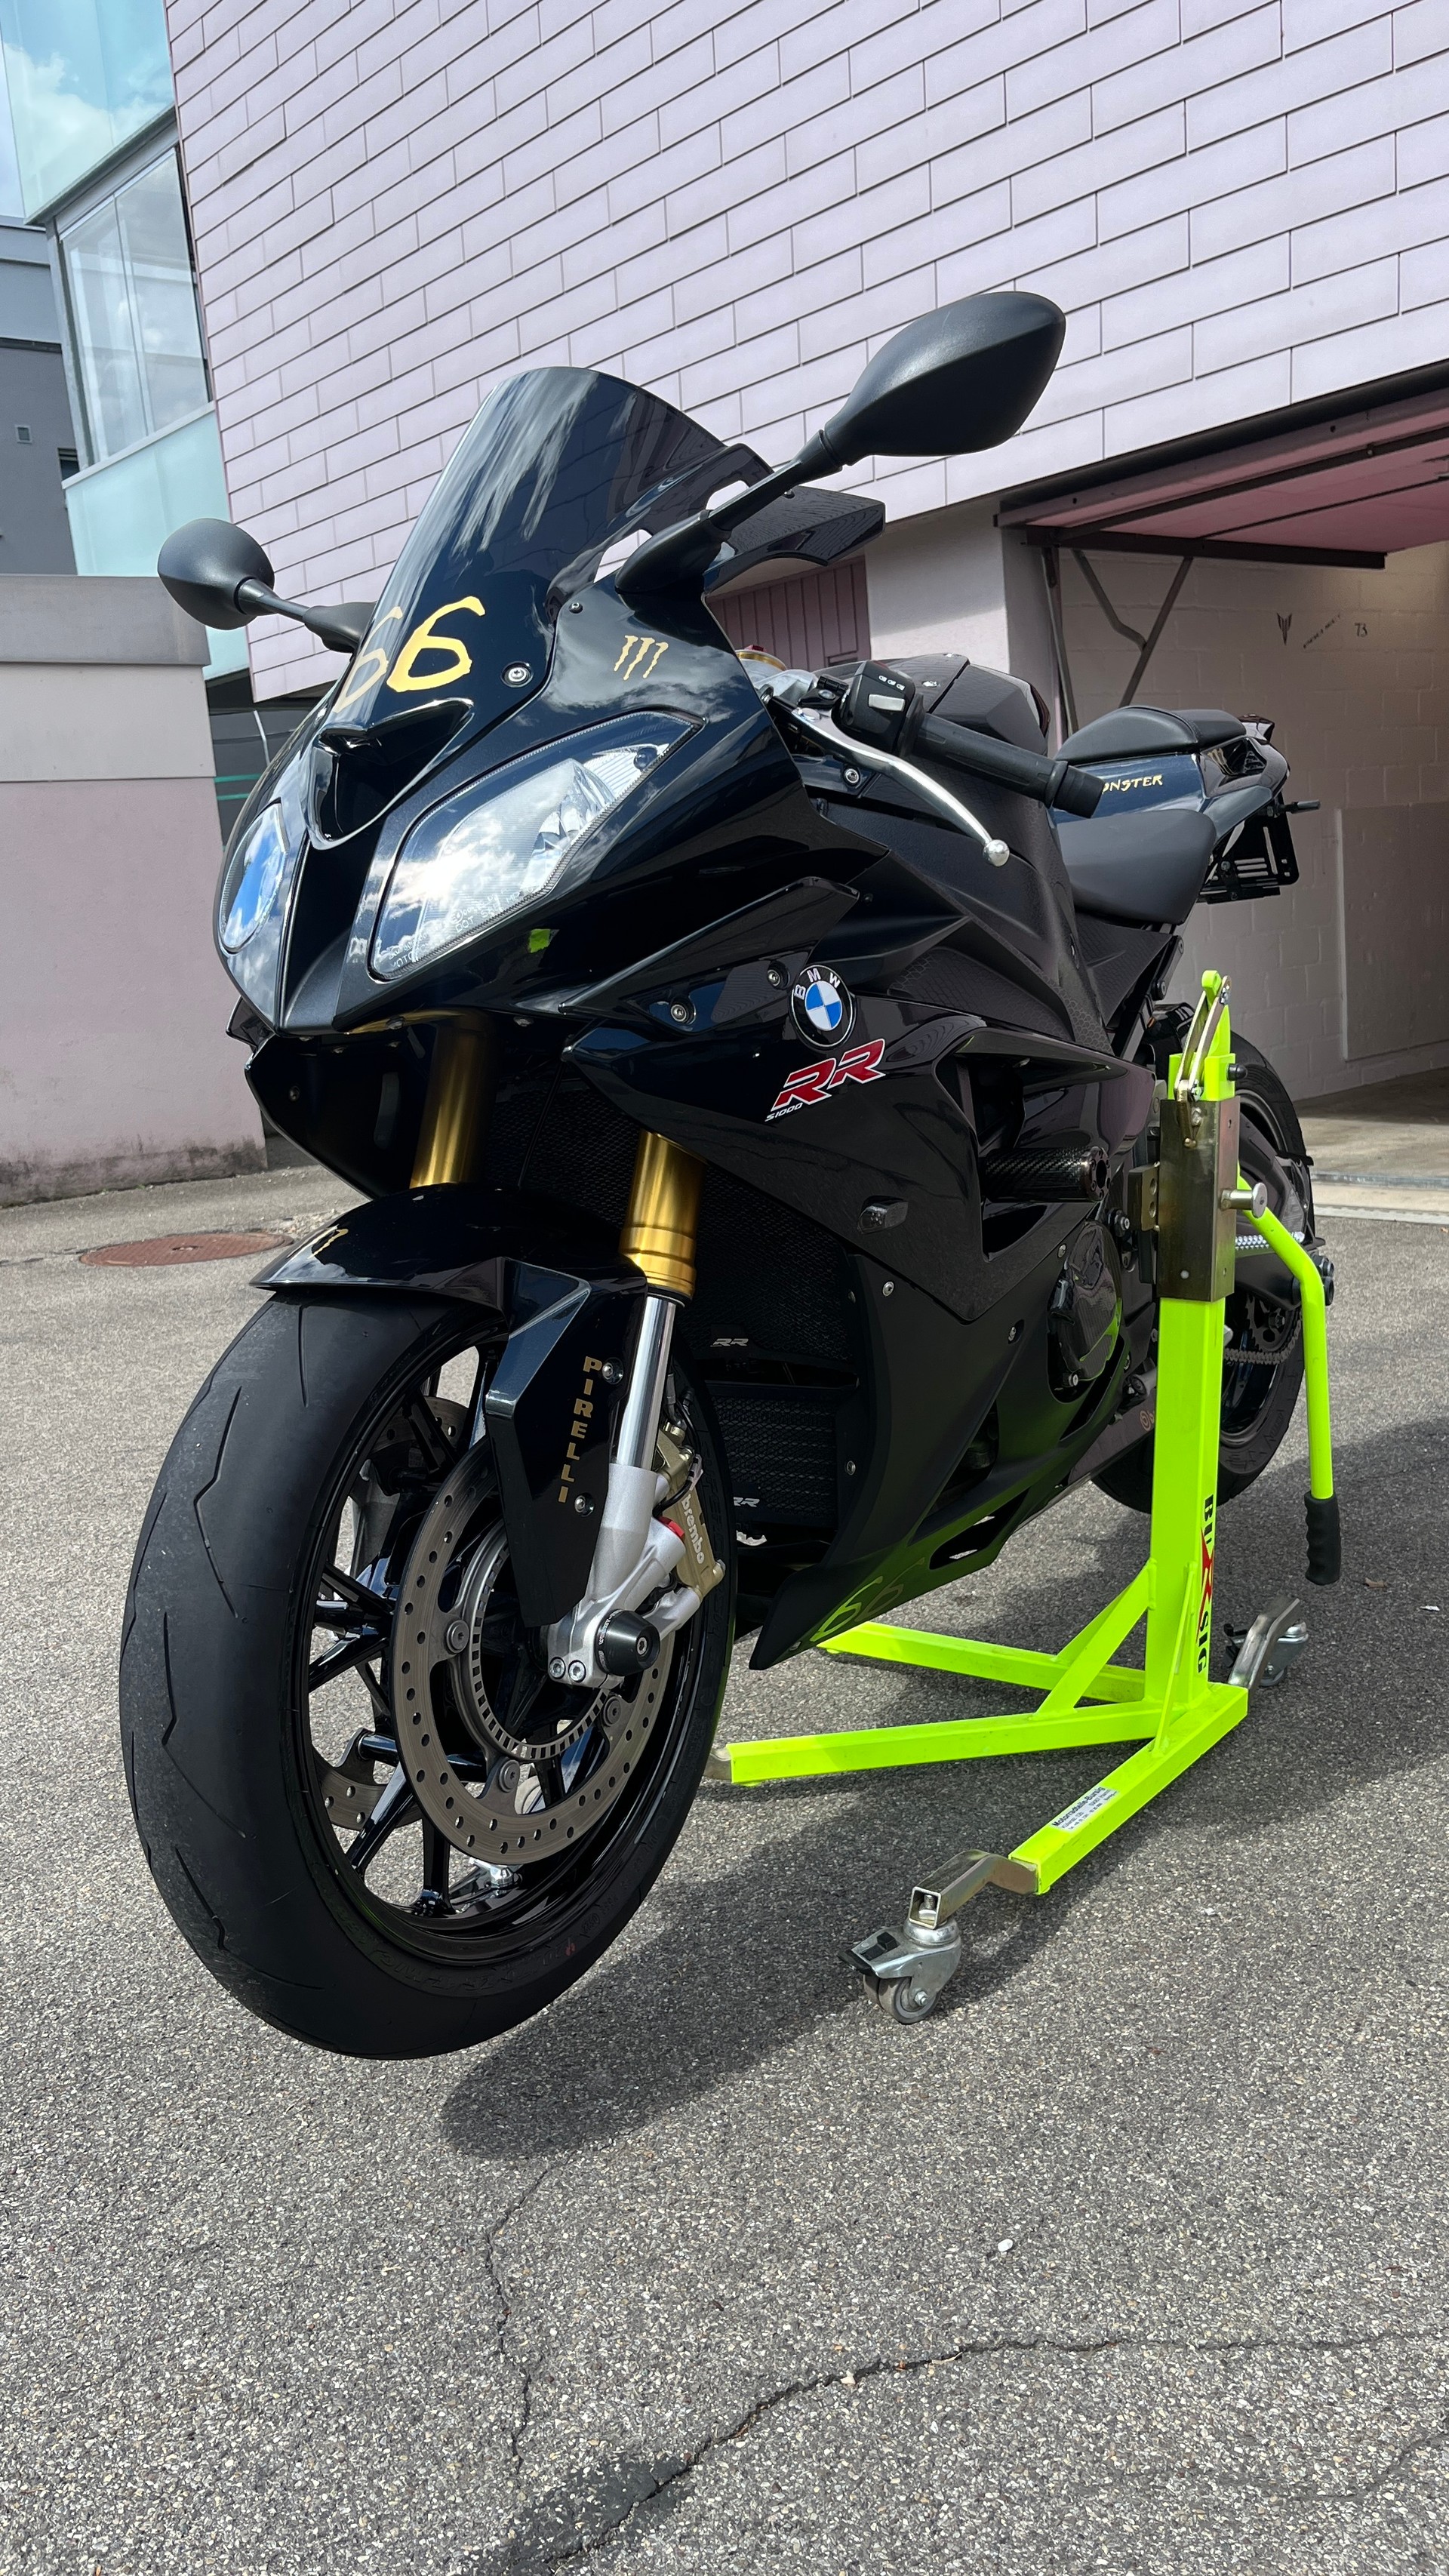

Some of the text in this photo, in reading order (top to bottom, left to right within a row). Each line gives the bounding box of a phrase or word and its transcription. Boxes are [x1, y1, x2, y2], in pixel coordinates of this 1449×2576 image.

[332, 596, 485, 713] 66
[1101, 774, 1163, 794] ONSTER
[794, 968, 841, 1001] BMW
[770, 1038, 887, 1112] RR
[764, 1103, 804, 1122] S1000
[712, 1337, 749, 1346] RR
[558, 1356, 603, 1503] PIRELLI
[681, 1494, 705, 1564] brembo
